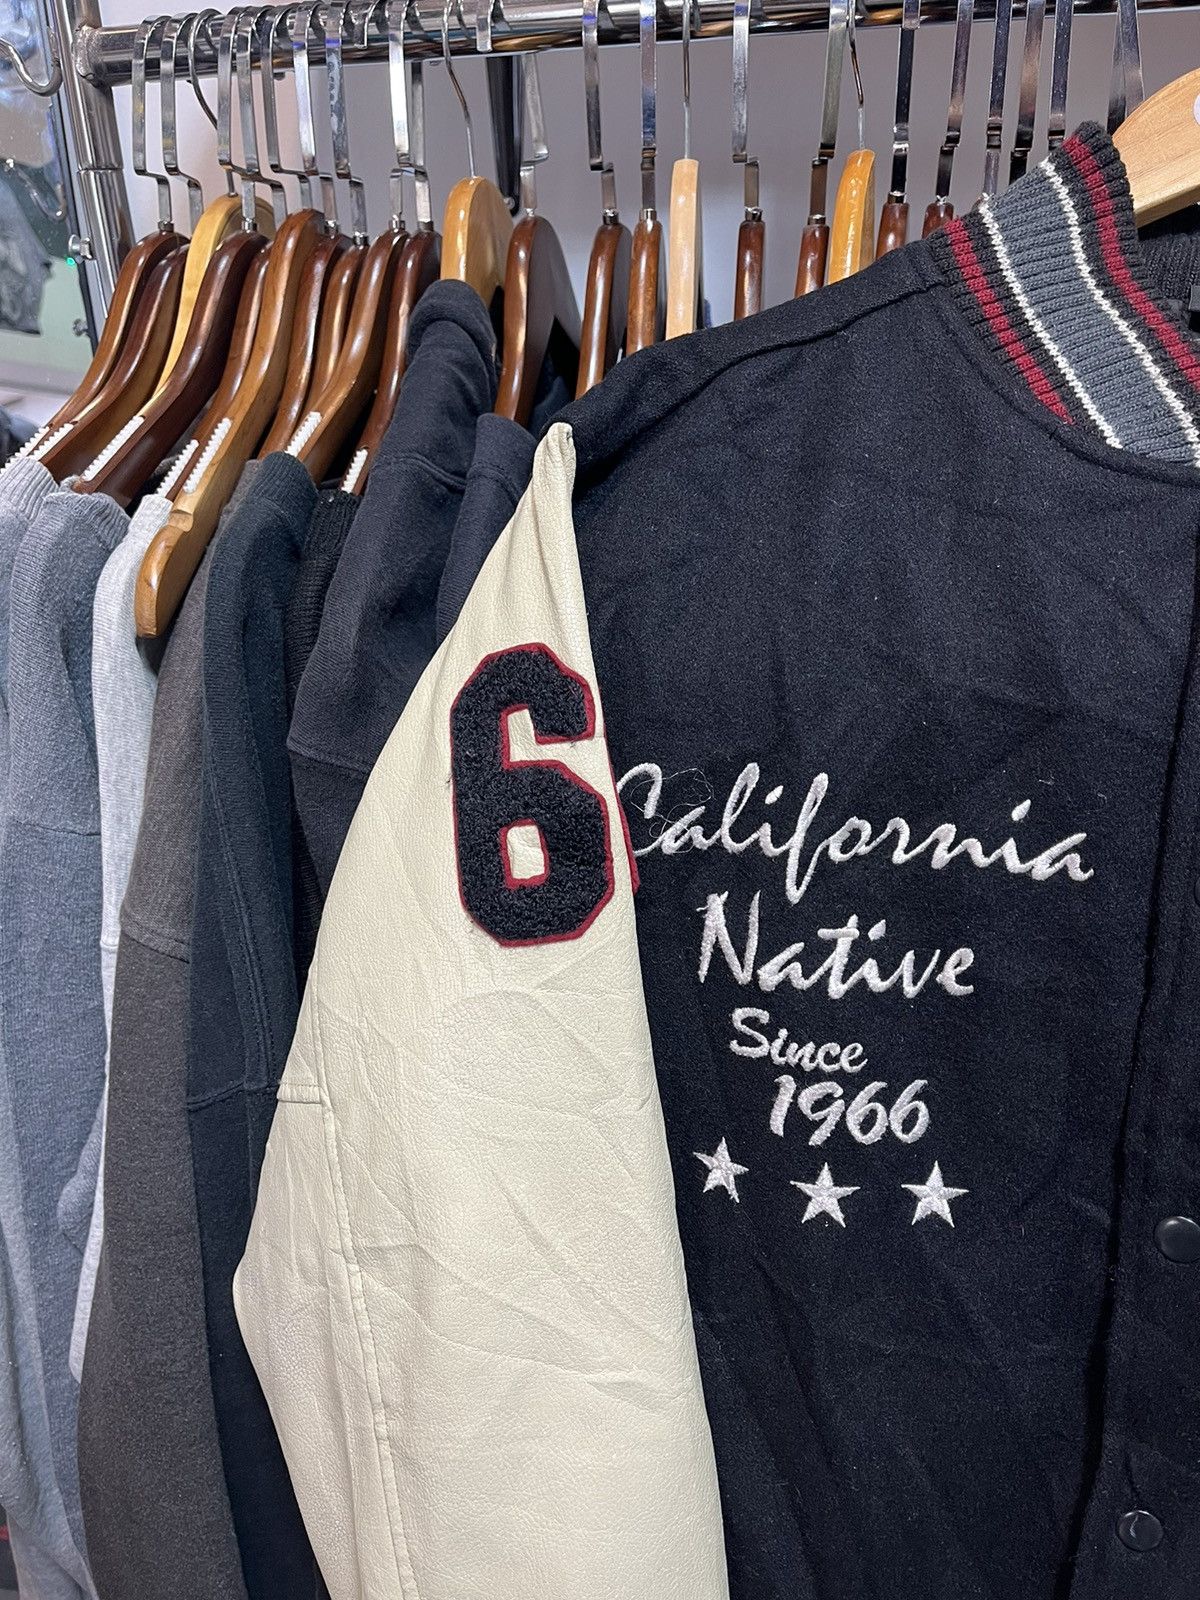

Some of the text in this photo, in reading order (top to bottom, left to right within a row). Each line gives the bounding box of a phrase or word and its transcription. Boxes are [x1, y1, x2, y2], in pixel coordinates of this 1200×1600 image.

[450, 642, 639, 947] 6
[616, 762, 1094, 903] California
[697, 890, 975, 999] Native
[730, 1007, 868, 1073] Since
[769, 1076, 931, 1146] 1966
